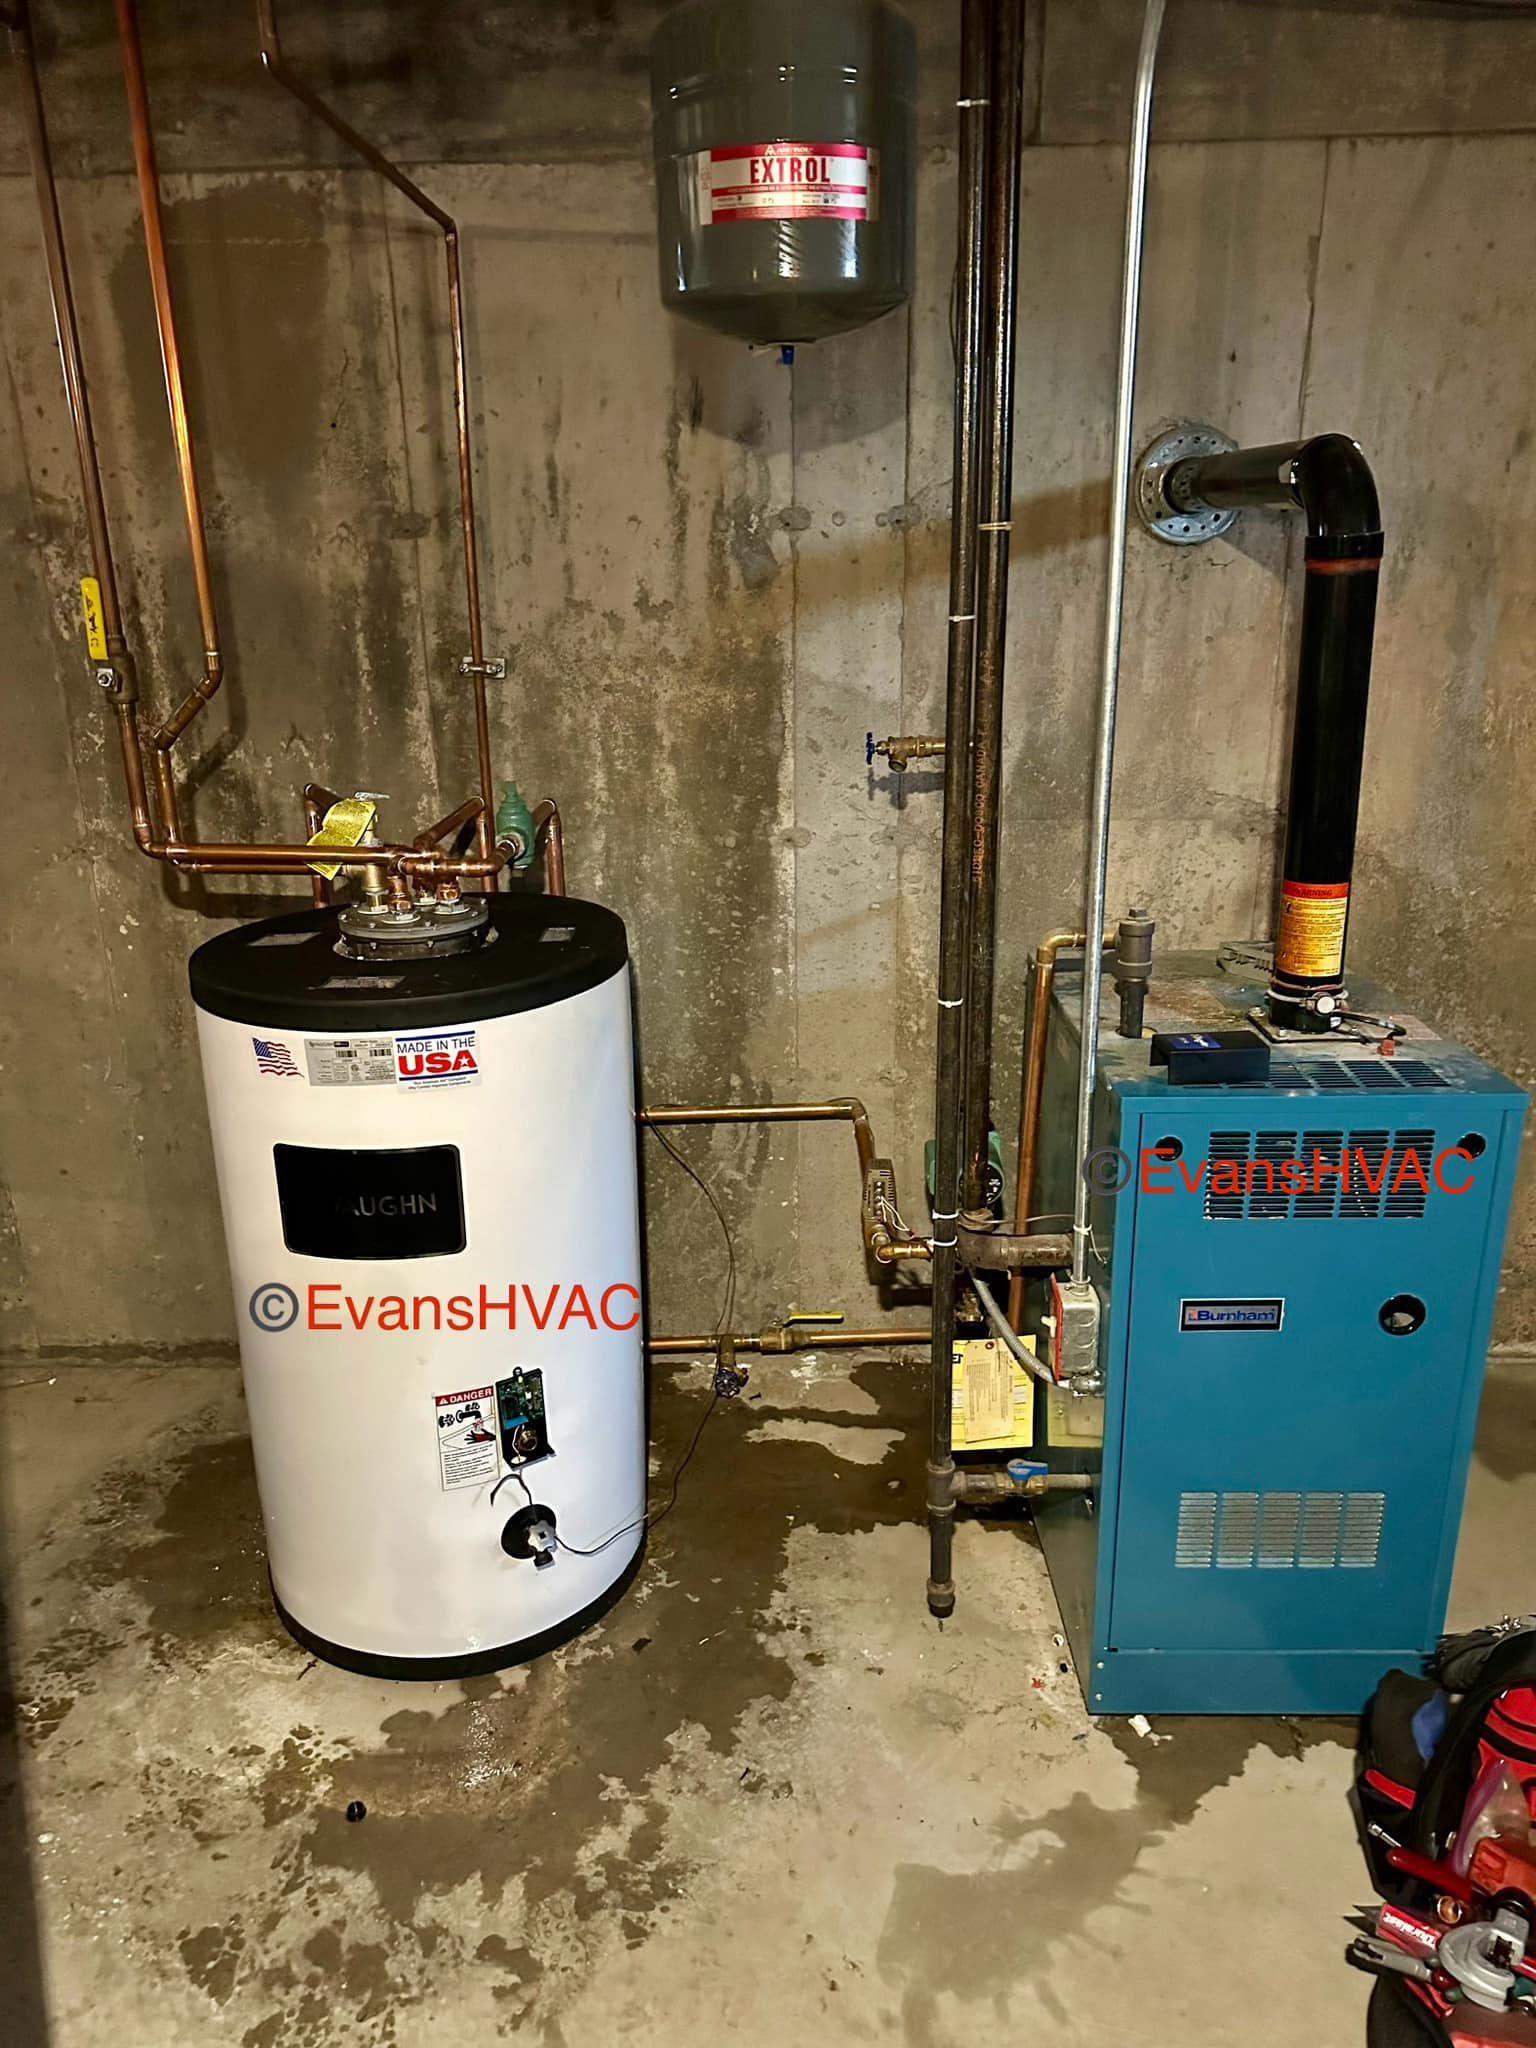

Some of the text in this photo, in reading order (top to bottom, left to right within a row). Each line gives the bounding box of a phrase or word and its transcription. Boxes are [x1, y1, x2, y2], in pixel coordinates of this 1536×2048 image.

[750, 157, 831, 184] EXTROL
[396, 1041, 433, 1054] MADE
[436, 1039, 449, 1051] IN
[450, 1036, 476, 1049] THE
[398, 1050, 477, 1076] USA
[336, 1192, 438, 1216] AUGHN
[1197, 1310, 1275, 1321] Burnham
[449, 1387, 492, 1404] DANGER
